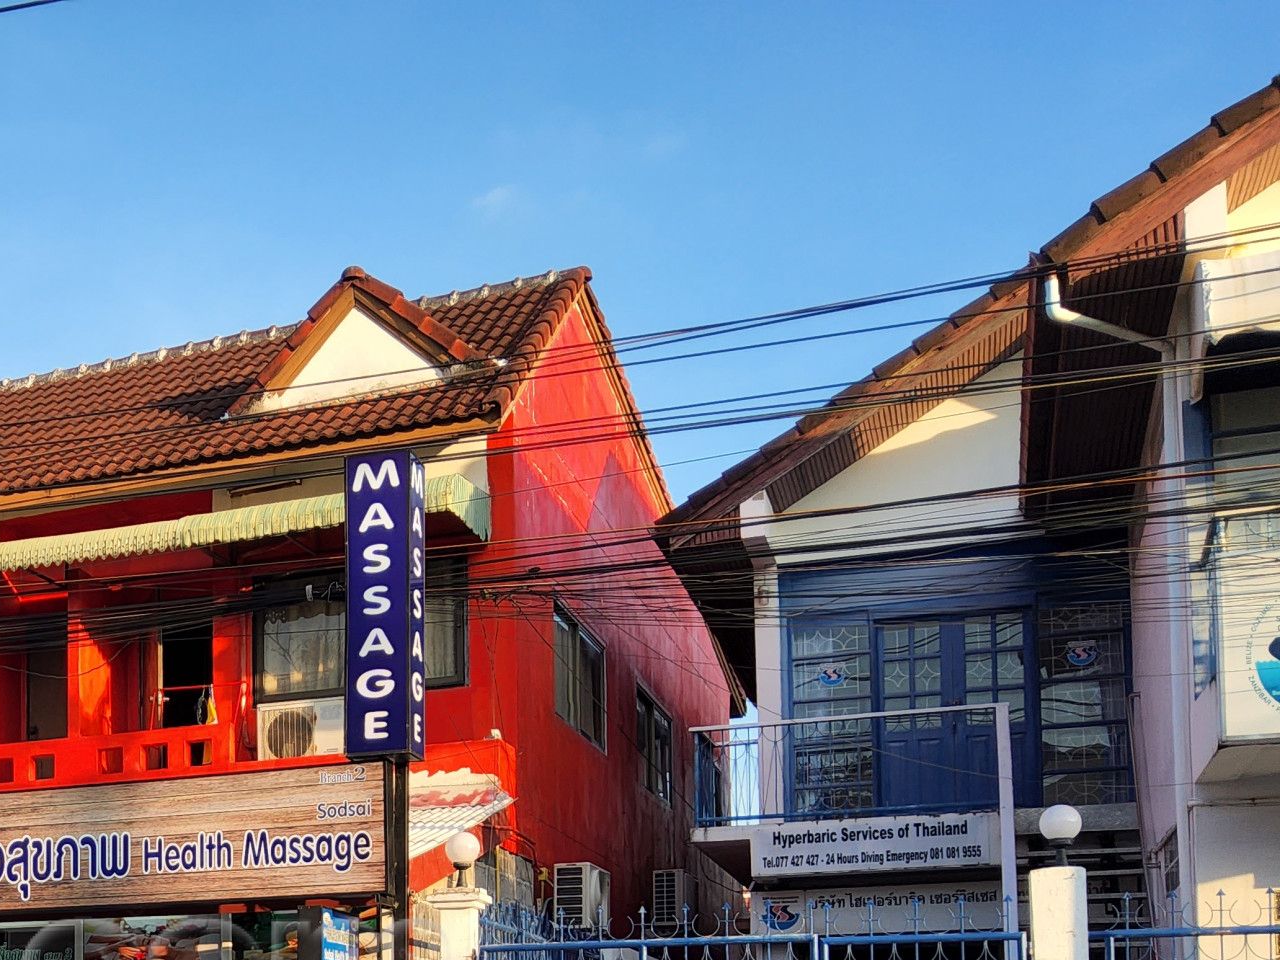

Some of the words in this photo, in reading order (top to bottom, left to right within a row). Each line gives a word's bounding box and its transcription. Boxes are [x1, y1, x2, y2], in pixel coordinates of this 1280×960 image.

[352, 459, 400, 739] MASSAGE
[411, 462, 423, 743] MASSAGE
[320, 770, 352, 784] Branch
[354, 767, 366, 781] 2
[317, 799, 371, 819] Sodsai
[773, 829, 837, 848] Hyperbaric
[841, 827, 894, 842] Services
[898, 826, 909, 838] of
[914, 820, 968, 838] Thailand
[144, 831, 232, 874] Health
[242, 829, 372, 873] Massage
[791, 855, 804, 867] 427
[806, 854, 819, 866] 427
[826, 853, 835, 865] 24
[837, 852, 859, 865] Hours
[861, 851, 884, 865] Diving
[886, 848, 928, 864] Emergency
[930, 848, 944, 860] 081
[946, 847, 960, 859] 081
[962, 845, 982, 858] 9555
